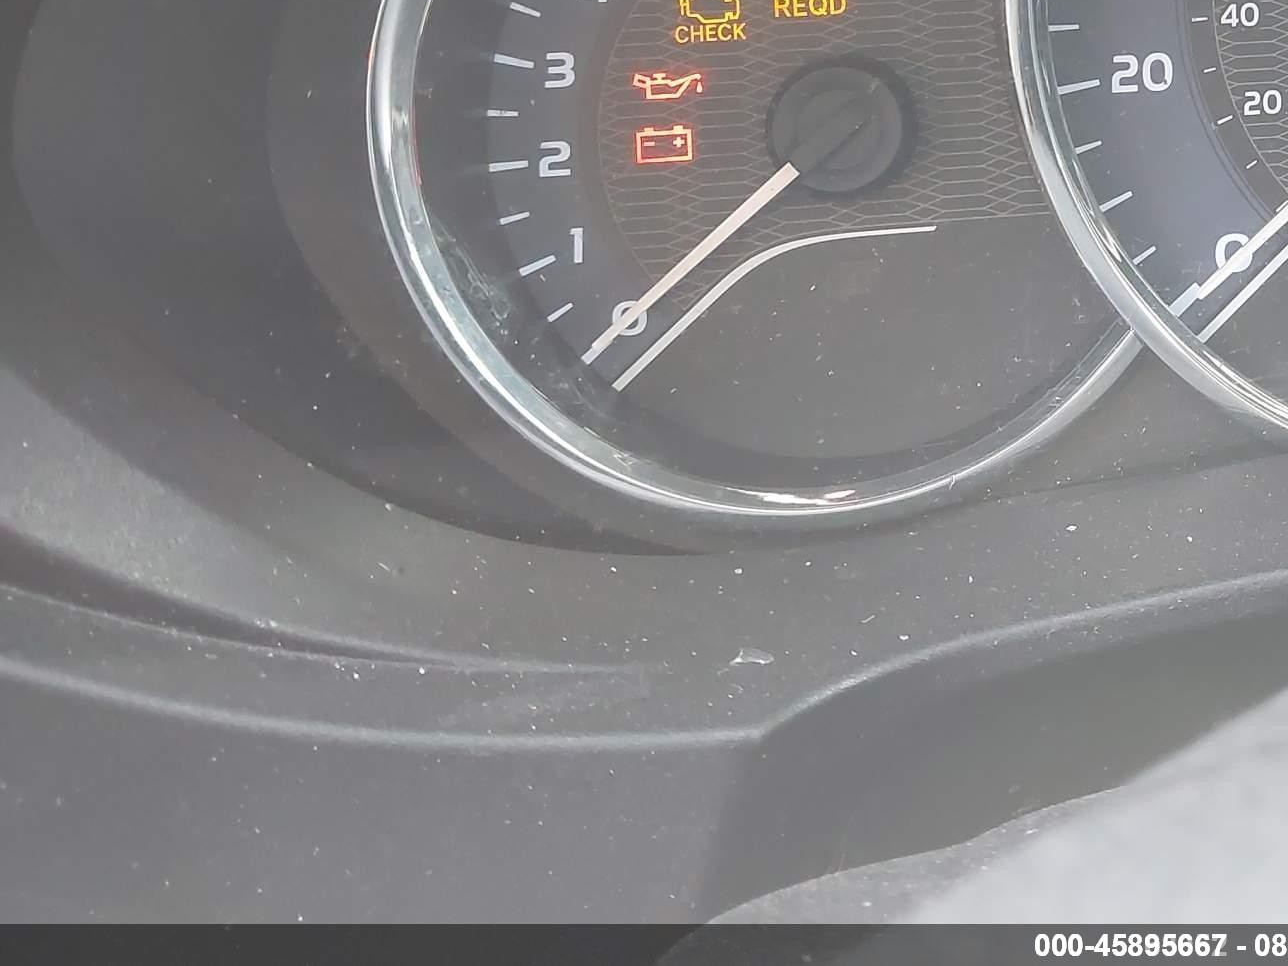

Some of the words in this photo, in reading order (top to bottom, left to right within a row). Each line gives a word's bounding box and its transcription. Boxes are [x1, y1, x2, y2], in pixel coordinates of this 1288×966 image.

[1220, 2, 1260, 27] 40
[674, 22, 746, 44] CHECK
[544, 52, 575, 88] 3
[1111, 52, 1174, 93] 20
[1243, 89, 1282, 115] 20
[539, 140, 571, 177] 2
[570, 227, 584, 264] 1
[1215, 233, 1252, 273] 0
[612, 300, 647, 335] 0
